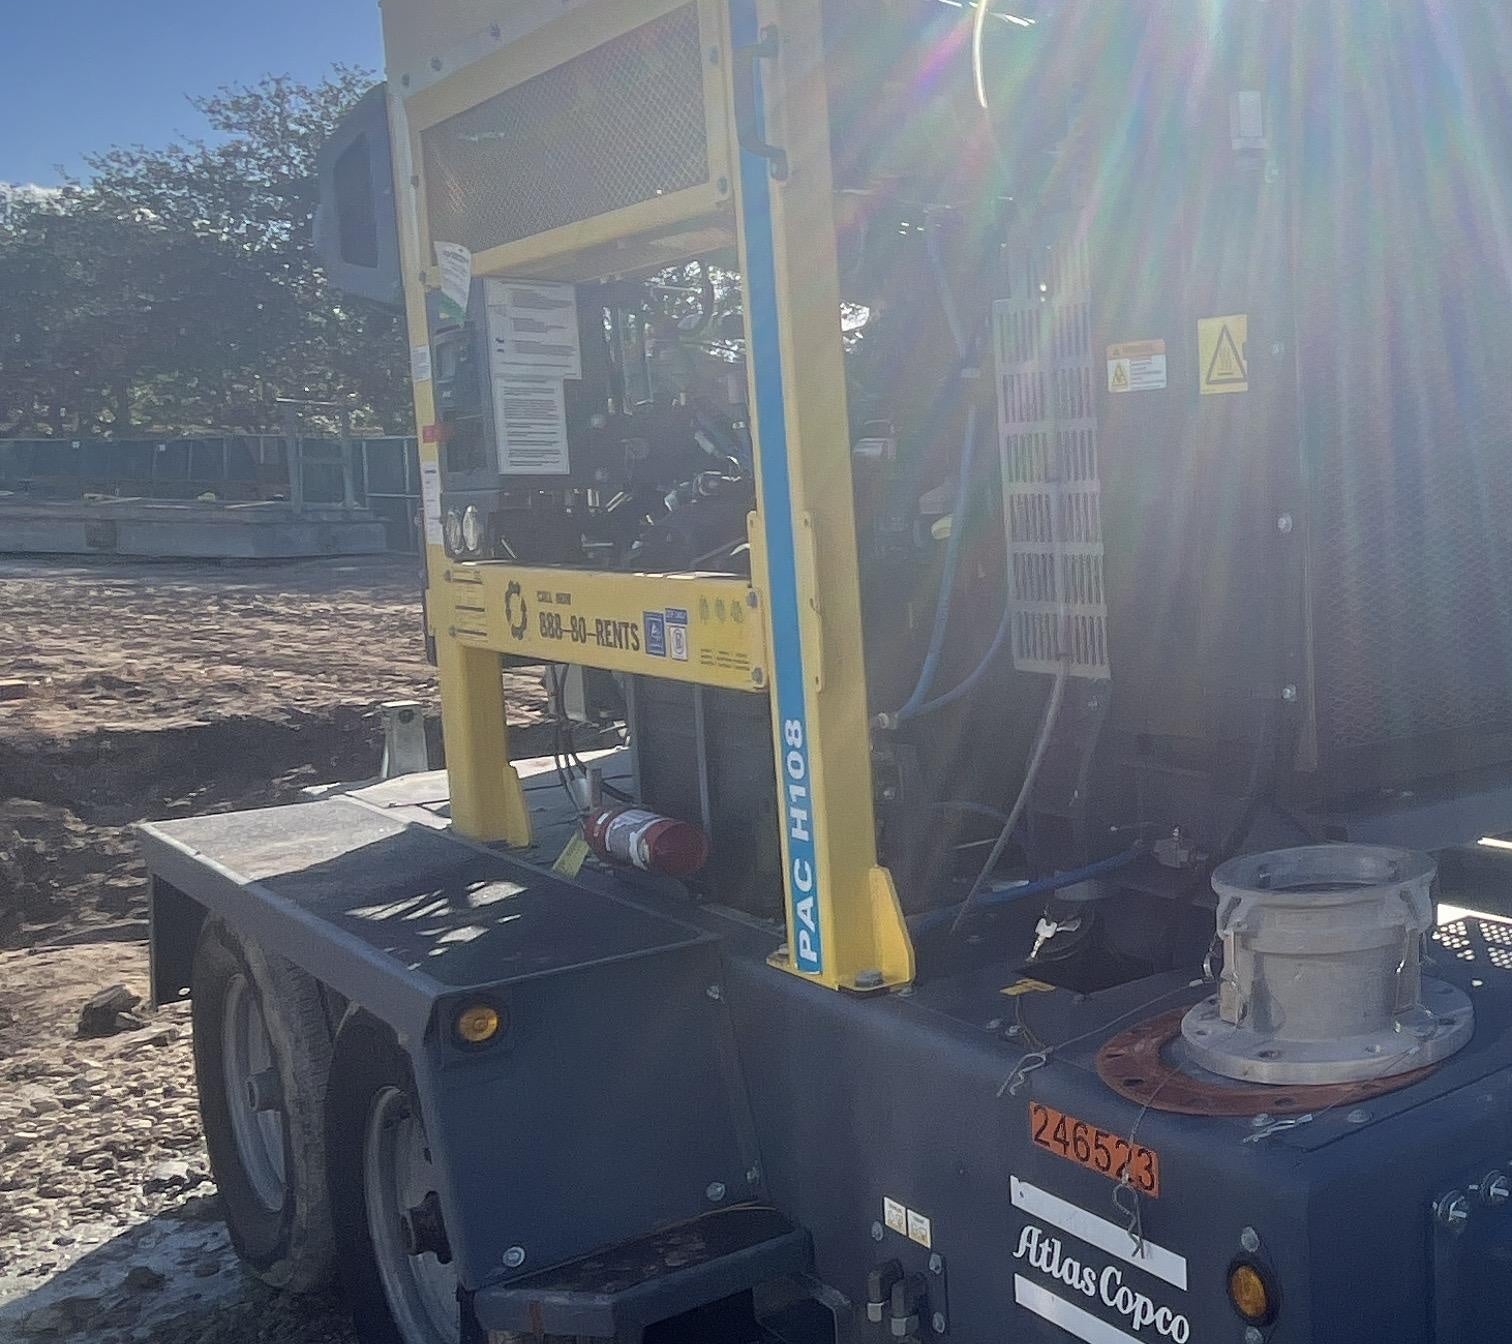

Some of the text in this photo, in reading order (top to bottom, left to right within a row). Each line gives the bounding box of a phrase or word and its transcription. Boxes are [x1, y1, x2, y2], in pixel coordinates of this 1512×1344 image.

[784, 718, 818, 963] PAC H108
[1032, 1105, 1156, 1192] 246523
